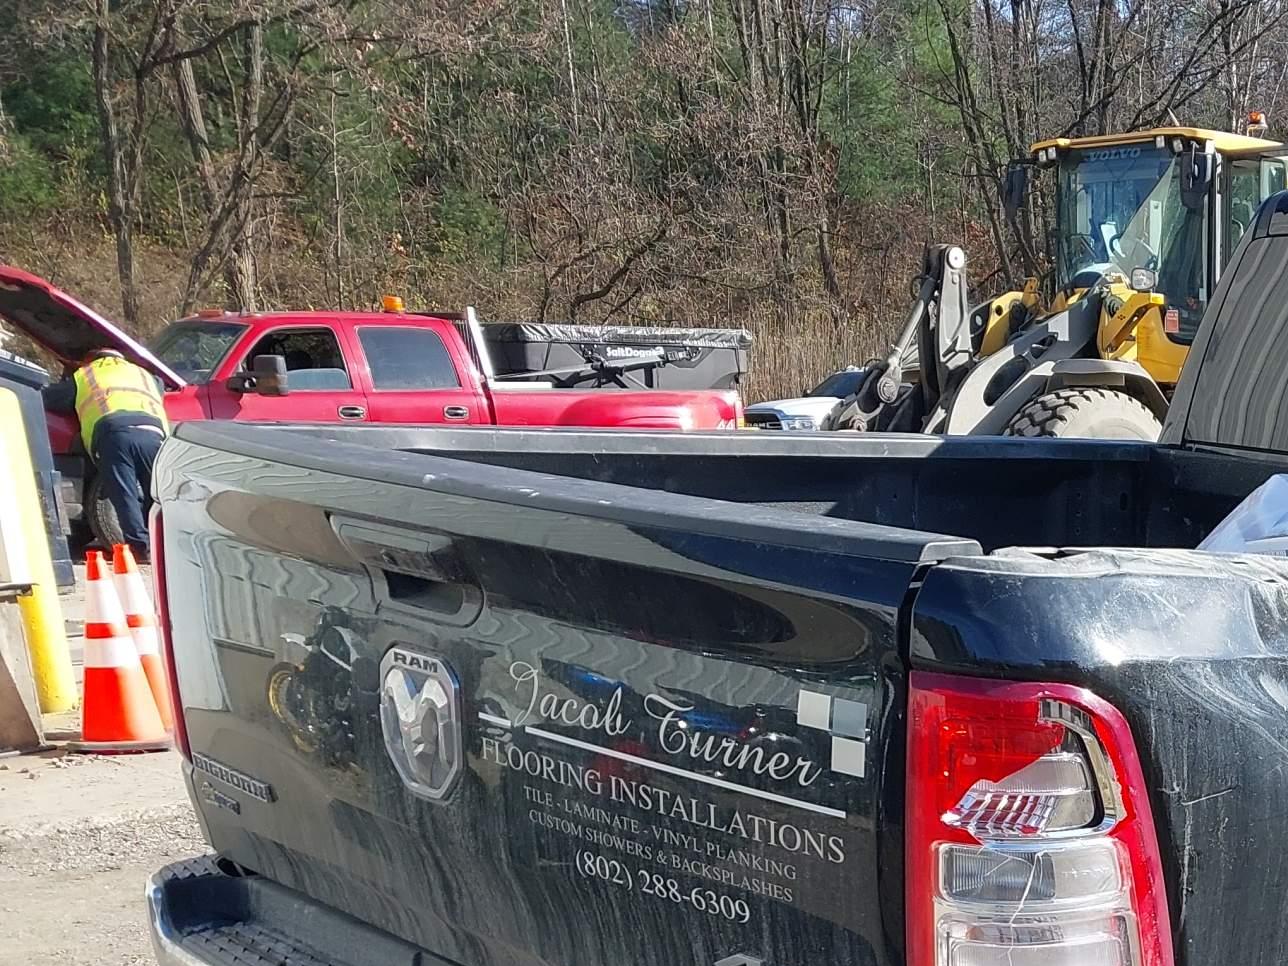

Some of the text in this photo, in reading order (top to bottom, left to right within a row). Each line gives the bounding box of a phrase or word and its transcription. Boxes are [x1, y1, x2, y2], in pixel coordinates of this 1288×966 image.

[1088, 148, 1141, 161] VOLVO
[393, 651, 438, 673] RAM
[509, 661, 822, 787] Jacob Turner
[480, 736, 846, 865] FLOORING INSTALLATIONS
[523, 785, 553, 807] TILE
[564, 799, 641, 834] LAMINATE
[651, 825, 702, 853] VINYL
[706, 841, 797, 880] PLANKING
[529, 809, 793, 902] CUSTOM SHOWERS & BACKSPLASHES
[575, 848, 751, 924] (802) 288-6309
